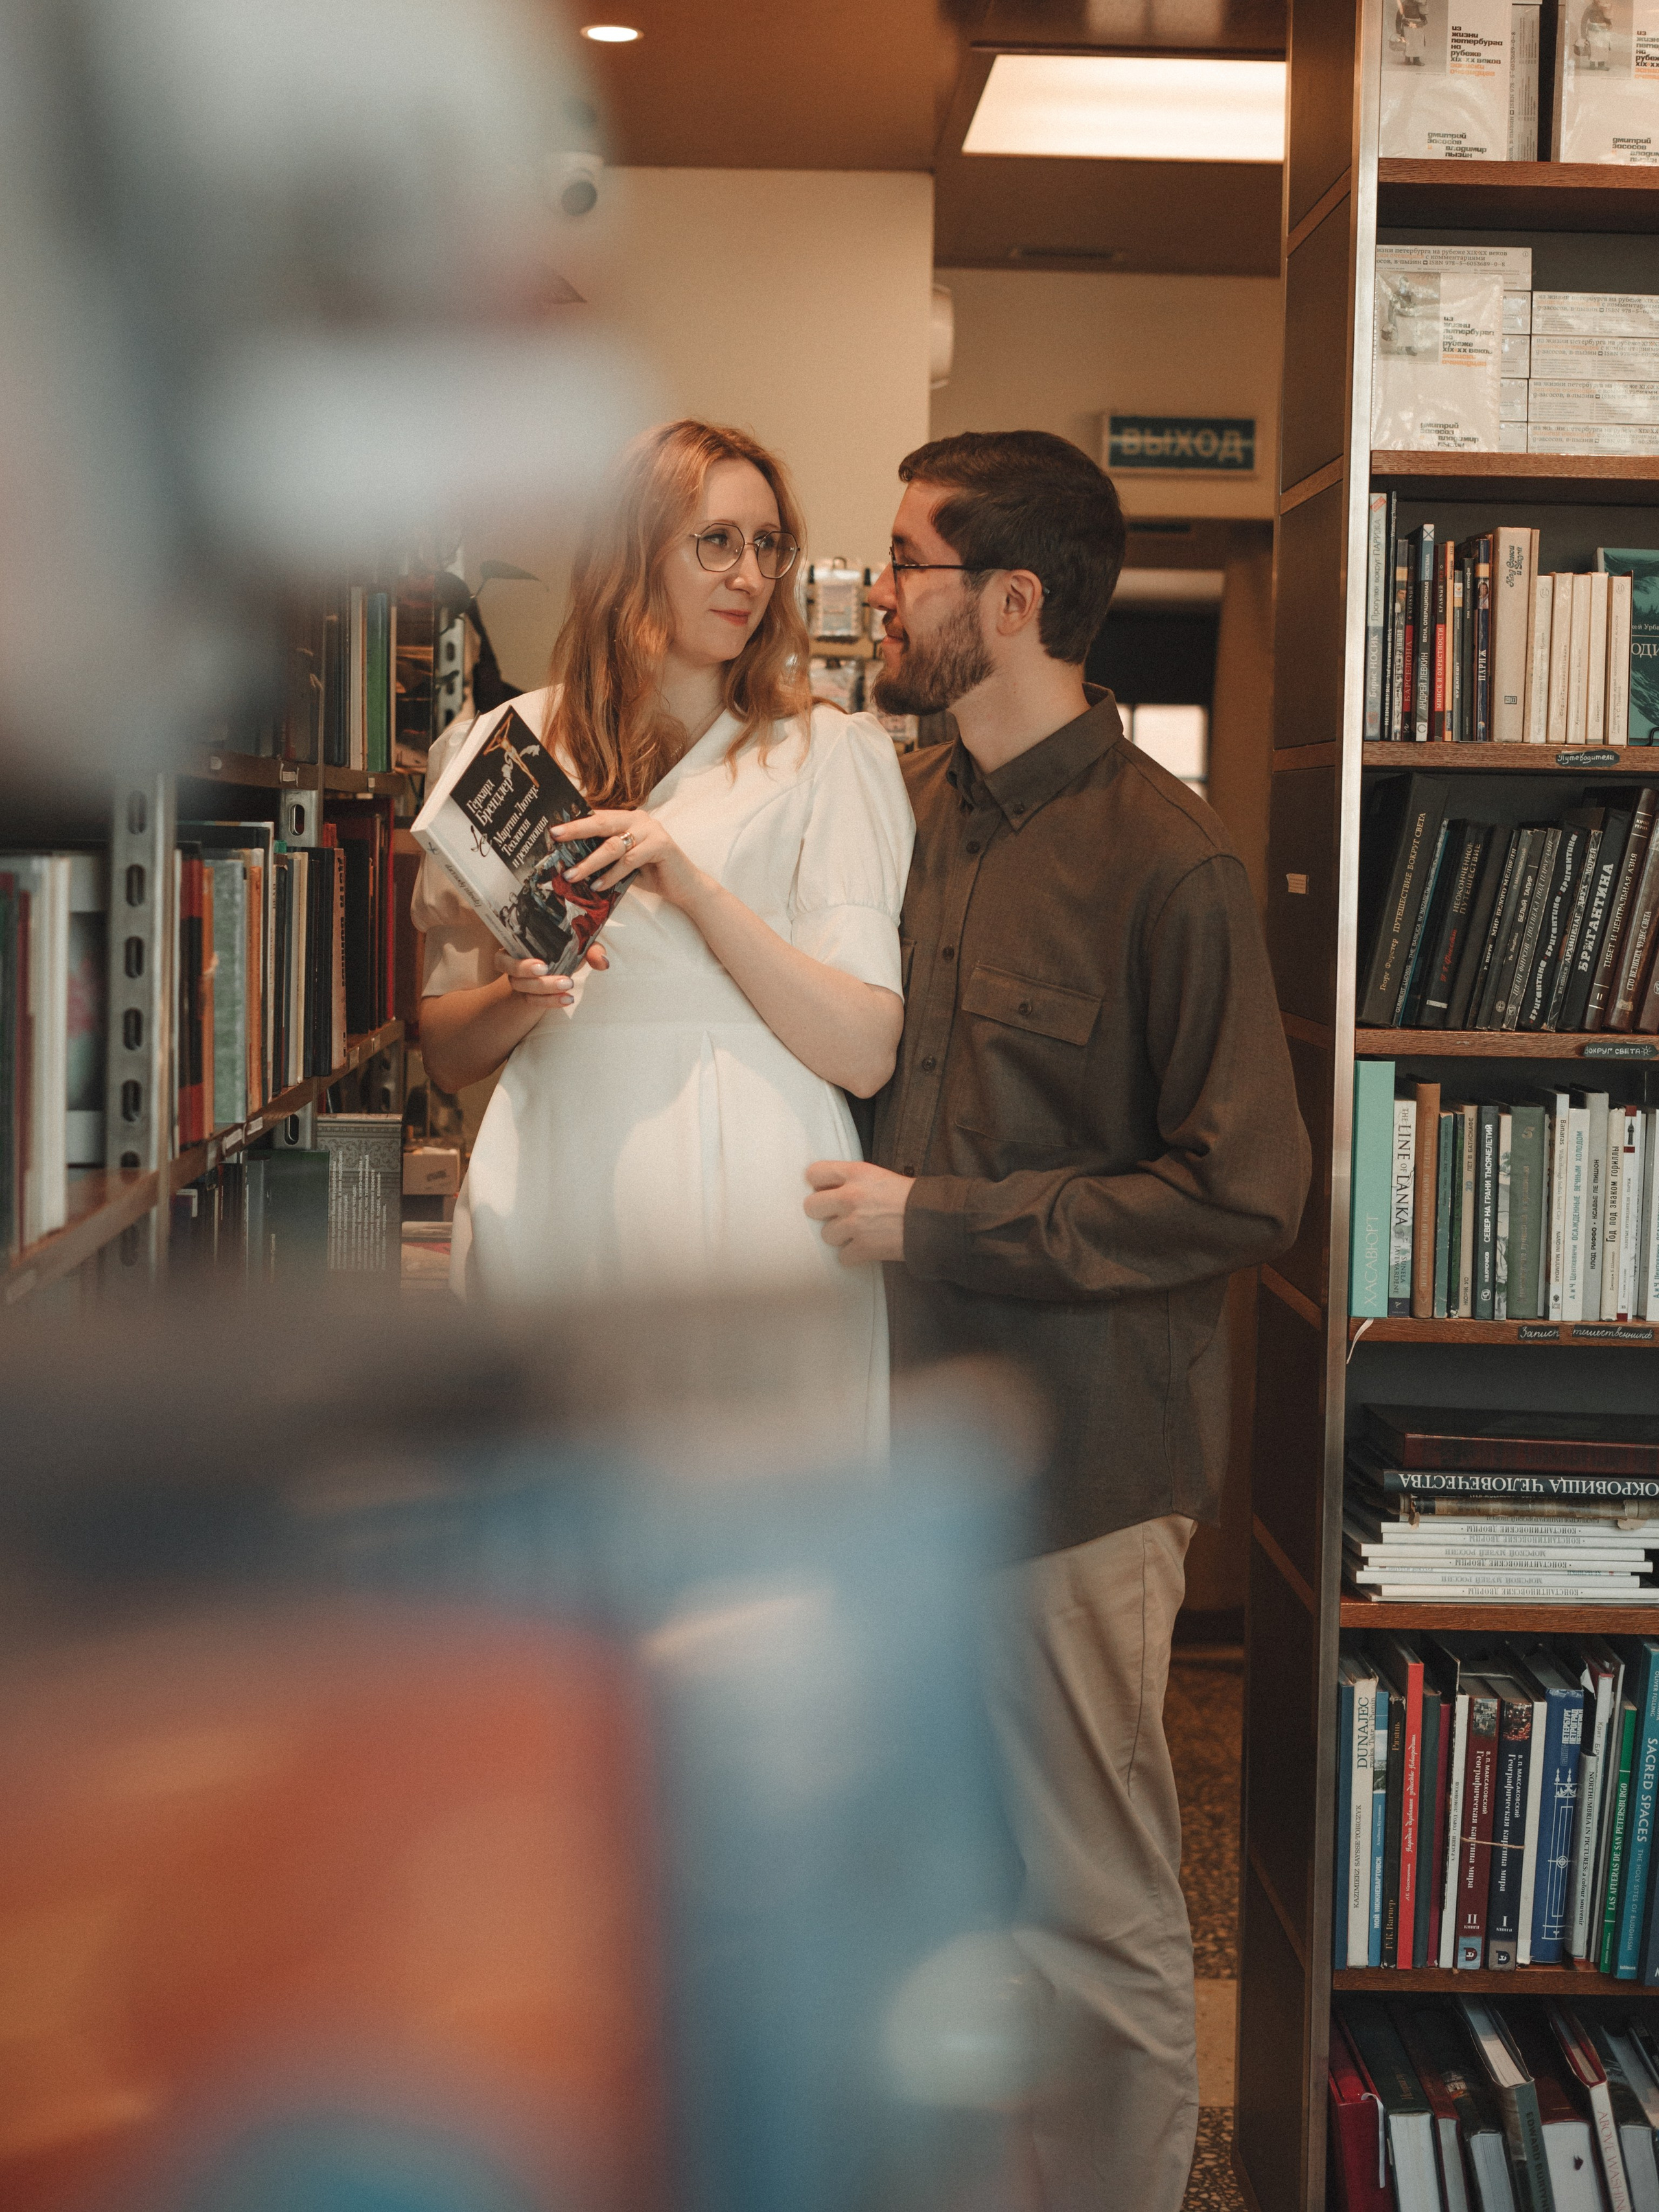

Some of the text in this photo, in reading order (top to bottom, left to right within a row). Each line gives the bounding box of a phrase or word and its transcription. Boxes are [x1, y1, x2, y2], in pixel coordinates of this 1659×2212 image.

[1450, 50, 1481, 59] рубеже
[1451, 38, 1503, 47] петербурга
[1121, 427, 1244, 463] ВЫХОД
[1506, 545, 1516, 587] Над Сеной
[1371, 586, 1380, 622] Прогулки
[1369, 672, 1378, 697] Борис
[1420, 653, 1428, 681] ЛЕВКИН
[1478, 649, 1487, 681] ПАРИЖ
[1419, 682, 1428, 710] АНДРЕЙ
[1557, 753, 1614, 765] Путеводители
[467, 779, 495, 814] Герхард
[475, 778, 514, 826] Брендлер
[493, 785, 539, 846] Мартин Лютер:
[501, 819, 531, 856] Теология
[516, 815, 548, 865] революция
[1459, 844, 1481, 914] ПУТЕШЕСТВИЕ
[1491, 848, 1516, 937] МИР БЕЛОГО МЕДВЕДЯ
[1518, 876, 1533, 922] БЕЛЫЙ ТАПИР
[1380, 813, 1426, 991] Георг Форстер ПУТЕШЕСТВИЕ ВОКРУГ СВЕТА
[1513, 841, 1553, 996] ИВАН ФИРСОВ ПОЛВЕКА ПОД ПАРУСАМИ
[1564, 848, 1597, 964] АРХИПЕЛАГ ДВУХ МОРЕЙ
[1578, 863, 1614, 972] БРИГАНТИНА
[1603, 853, 1638, 968] ТИБЕТ ЦЕНТРАЛЬНАЯ АЗИЯ
[1396, 924, 1421, 1013] GUMBERT LUDWIG BASILICA
[1627, 911, 1651, 991] СТО ВЕЛИКИХ ЧУДЕС СВЕТА
[1397, 1124, 1411, 1160] LINE
[1484, 1124, 1492, 1178] ТЫСЯЧЕЛЕТИЙ
[1400, 1163, 1407, 1172] OF
[1466, 1181, 1472, 1192] 20
[1395, 1174, 1410, 1226] LANKA
[1484, 1205, 1491, 1217] НА
[1606, 1146, 1619, 1242] Год под знаком гориллы
[1572, 1195, 1580, 1240] ОСАЖДЕННЫЕ
[1364, 1213, 1378, 1307] ХАСАВЮРТ
[1398, 1474, 1544, 1493] ЧЕЛОВЕЧЕСТВА
[1500, 1526, 1577, 1534] КОНСТАНТИНОВСКИЕ
[1455, 1559, 1567, 1568] КОНСТАНТИНОВСКИЕ ДВОРЦЫ
[1357, 1697, 1369, 1769] DUNAJEC
[1643, 1738, 1657, 1790] SACRED
[1482, 1765, 1491, 1814] МАКСАКОВСКИЙ
[1586, 1771, 1595, 1824] NORTHUMBRIA
[1616, 1783, 1627, 1834] PETERSBURGO
[1387, 1722, 1400, 1930] Вагнер Рязань
[1467, 1751, 1484, 1889] Географическая мира
[1499, 1754, 1516, 1892] Географическая мира
[1637, 1794, 1651, 1843] SPACES
[1612, 1852, 1620, 1861] DE
[1614, 1836, 1622, 1850] SAN
[1609, 1863, 1619, 1894] AFUERAS
[1632, 1884, 1641, 1902] SITES
[1633, 1865, 1642, 1882] HOLY
[1467, 1914, 1478, 1924] II
[1627, 1915, 1636, 1950] BUDDHISM
[1526, 2112, 1540, 2161] EDWARD
[1598, 2112, 1615, 2153] ABOVE
